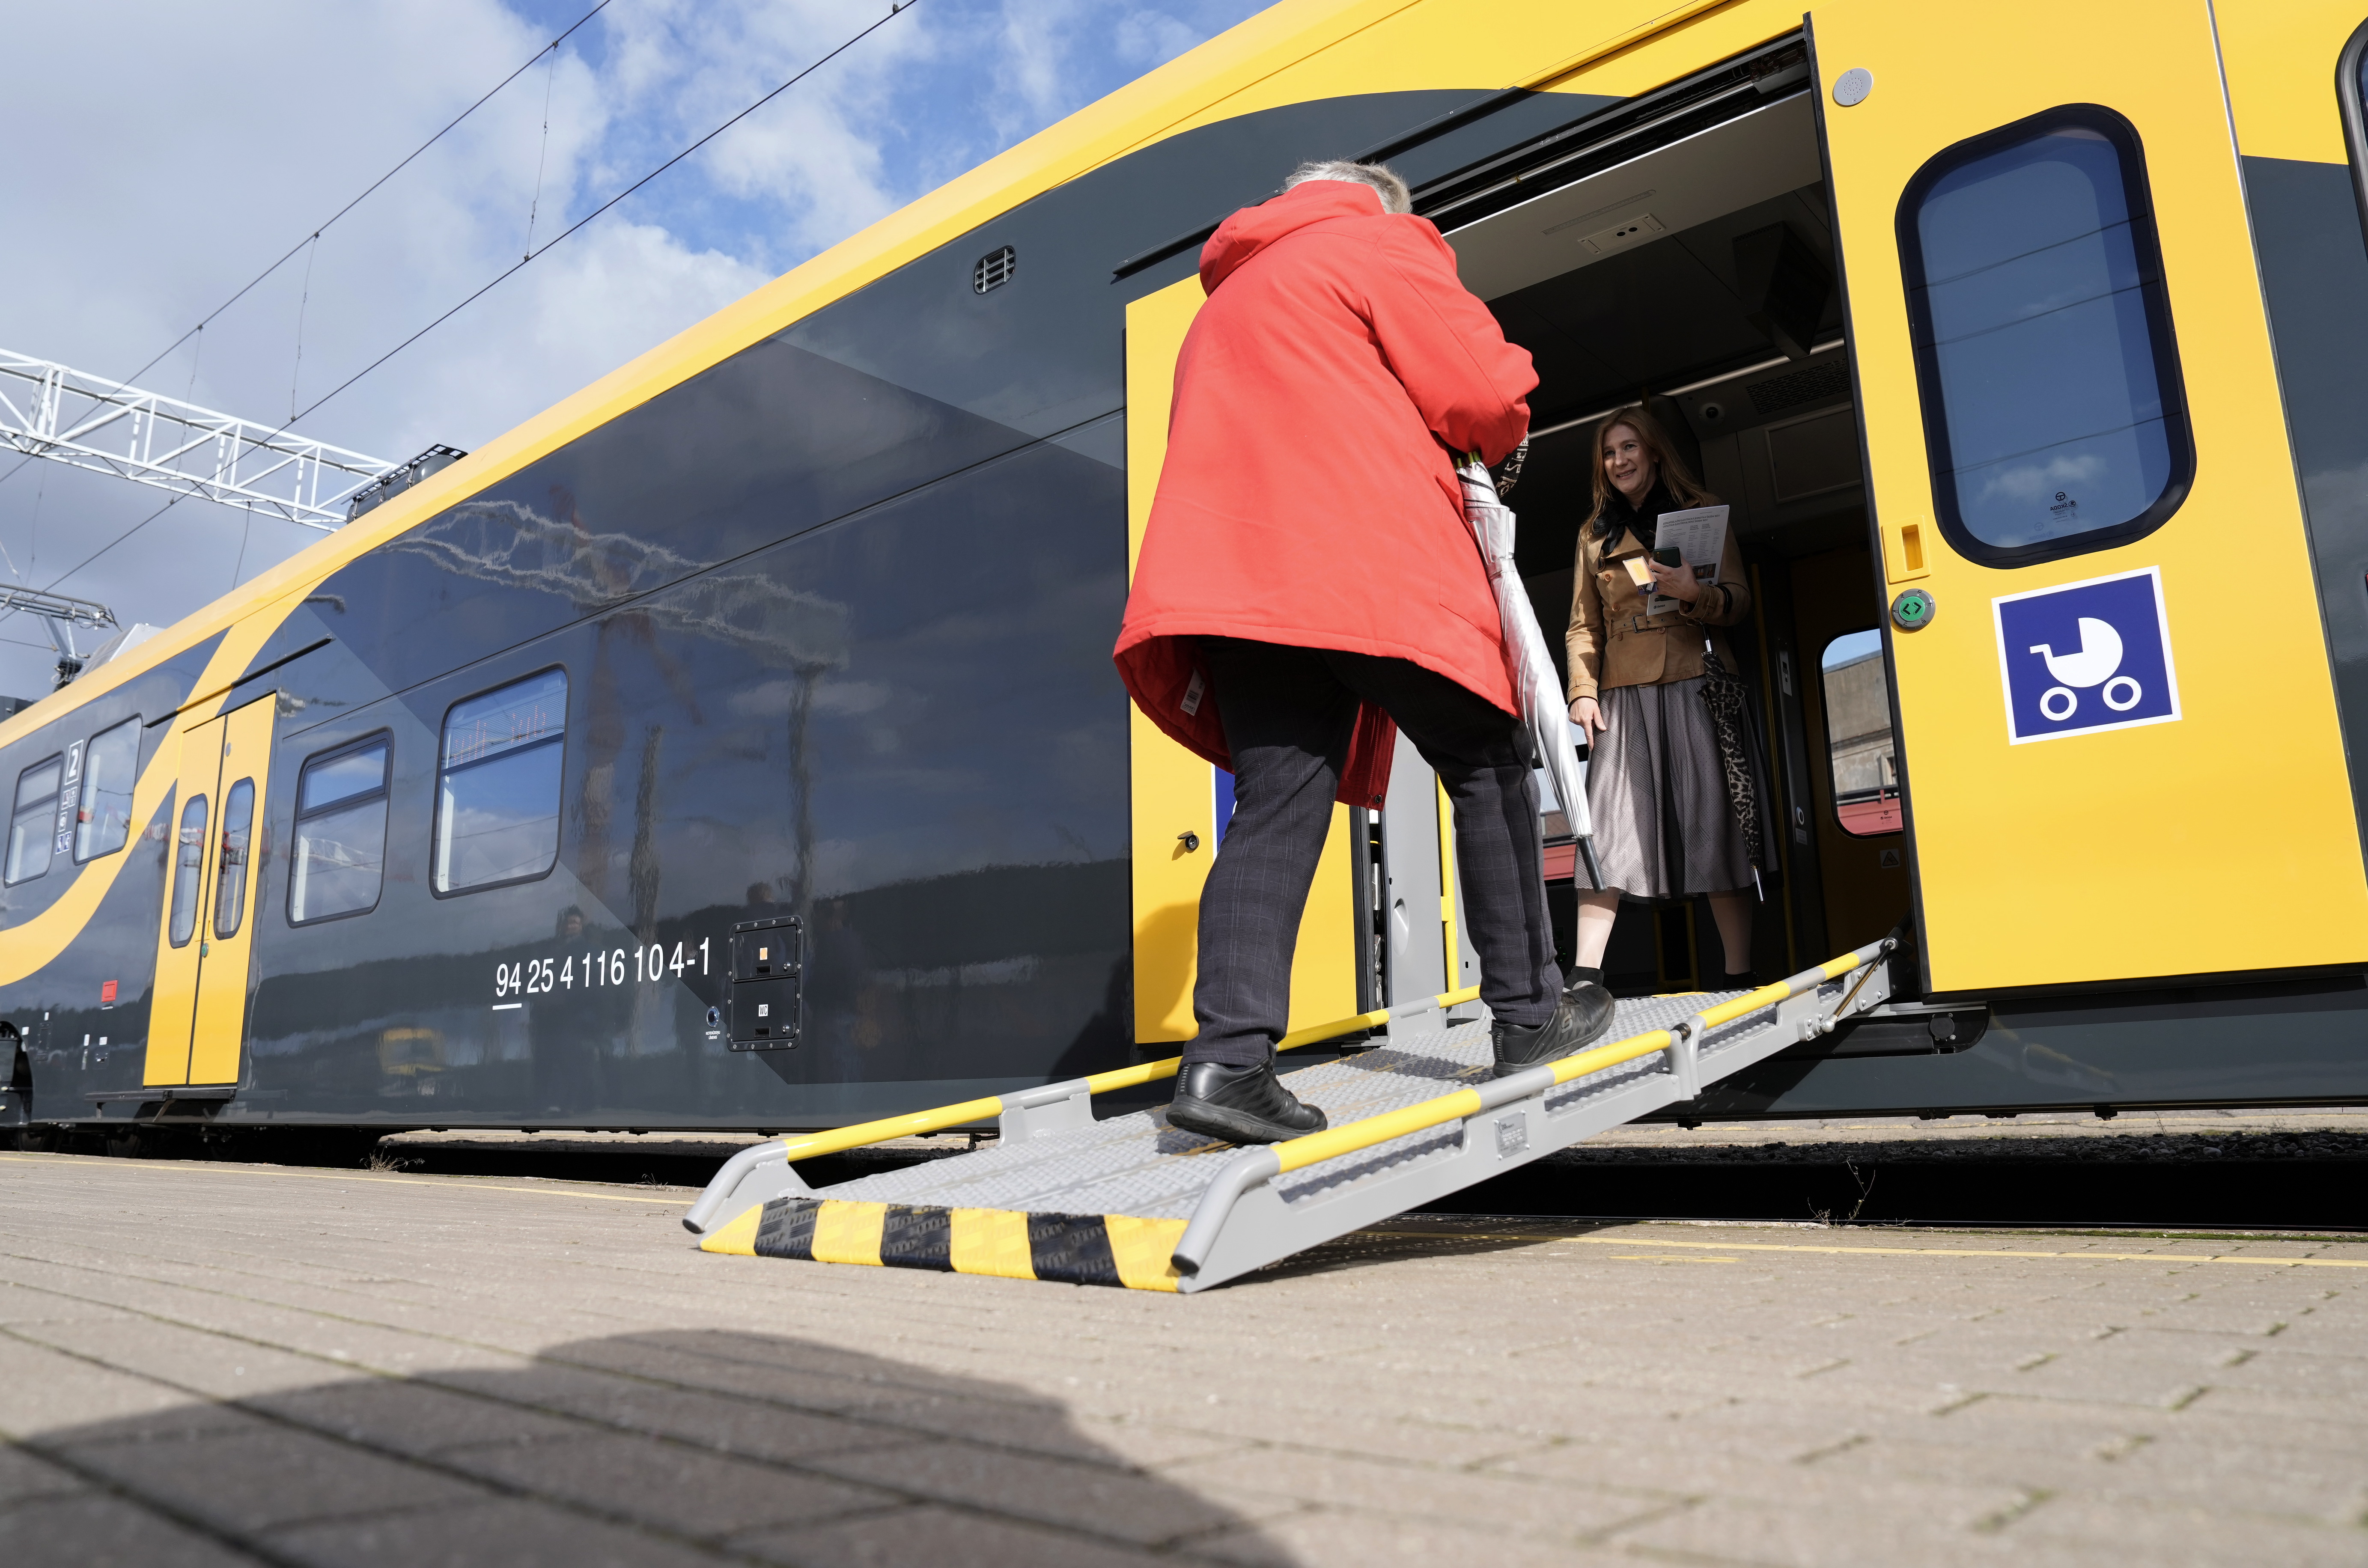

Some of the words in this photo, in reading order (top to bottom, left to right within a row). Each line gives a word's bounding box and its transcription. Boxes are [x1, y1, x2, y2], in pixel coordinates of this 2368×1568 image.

[68, 748, 79, 778] 2
[496, 963, 521, 997] 94
[527, 958, 554, 994] 25
[560, 956, 573, 989] 4
[583, 949, 625, 988] 116
[635, 937, 709, 982] 104-1
[760, 1006, 767, 1015] WC
